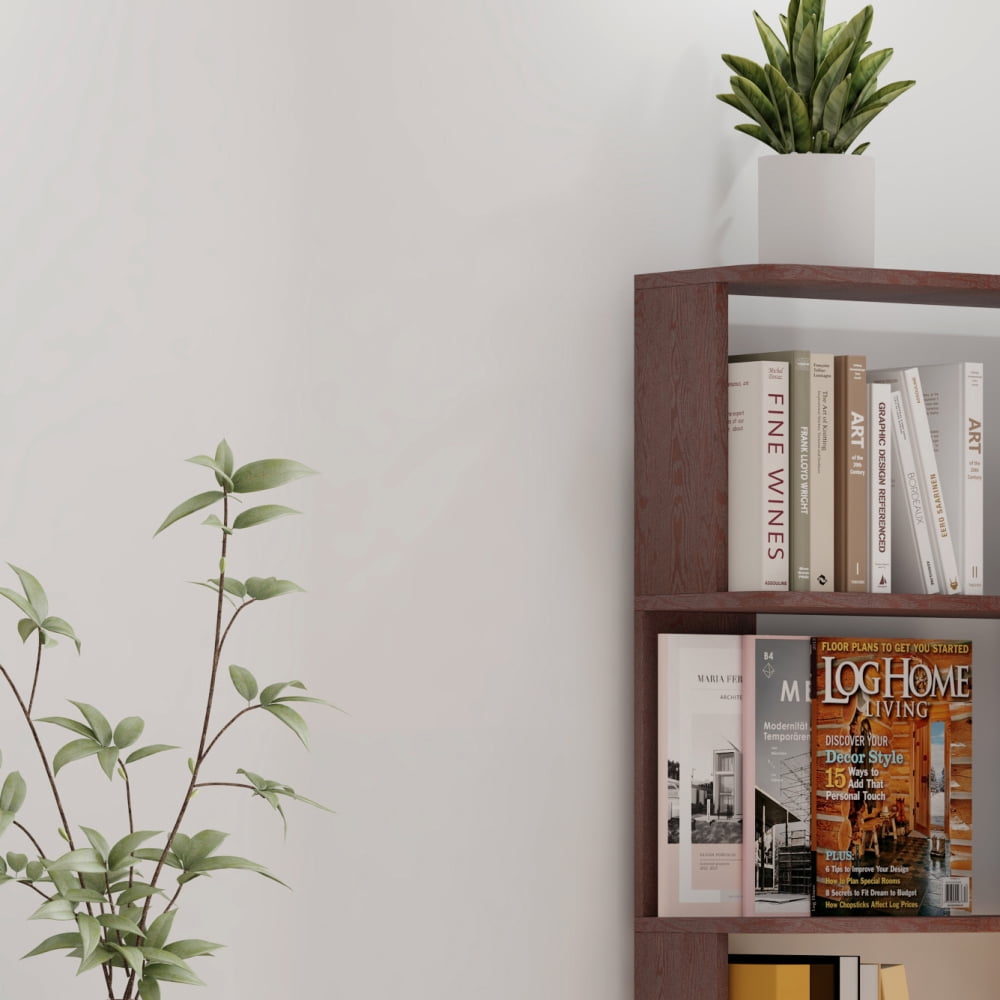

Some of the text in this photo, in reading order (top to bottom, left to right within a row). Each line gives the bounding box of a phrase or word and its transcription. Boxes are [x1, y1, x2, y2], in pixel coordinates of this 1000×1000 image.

[768, 393, 784, 455] FINE
[851, 411, 864, 449] ART
[969, 417, 981, 454] ART
[800, 426, 809, 514] FRANK LLOYD WRIGHT
[878, 402, 886, 553] GRAPHIC DESIGN REFERENCED
[907, 472, 923, 525] BORDEAUX
[768, 468, 784, 560] WINES
[822, 641, 849, 651] FLOOR
[851, 642, 879, 652] PLANS
[882, 643, 892, 652] TO
[894, 643, 910, 653] GET
[913, 643, 930, 653] YOU
[932, 644, 969, 654] STARTED
[866, 700, 928, 718] LIVING
[825, 735, 888, 746] DISCOVER YOUR
[825, 749, 904, 768] Decor Style
[825, 767, 879, 788] 15 Ways to
[848, 779, 884, 788] Add That
[825, 791, 886, 800] Personal Touch
[860, 877, 880, 885] Special
